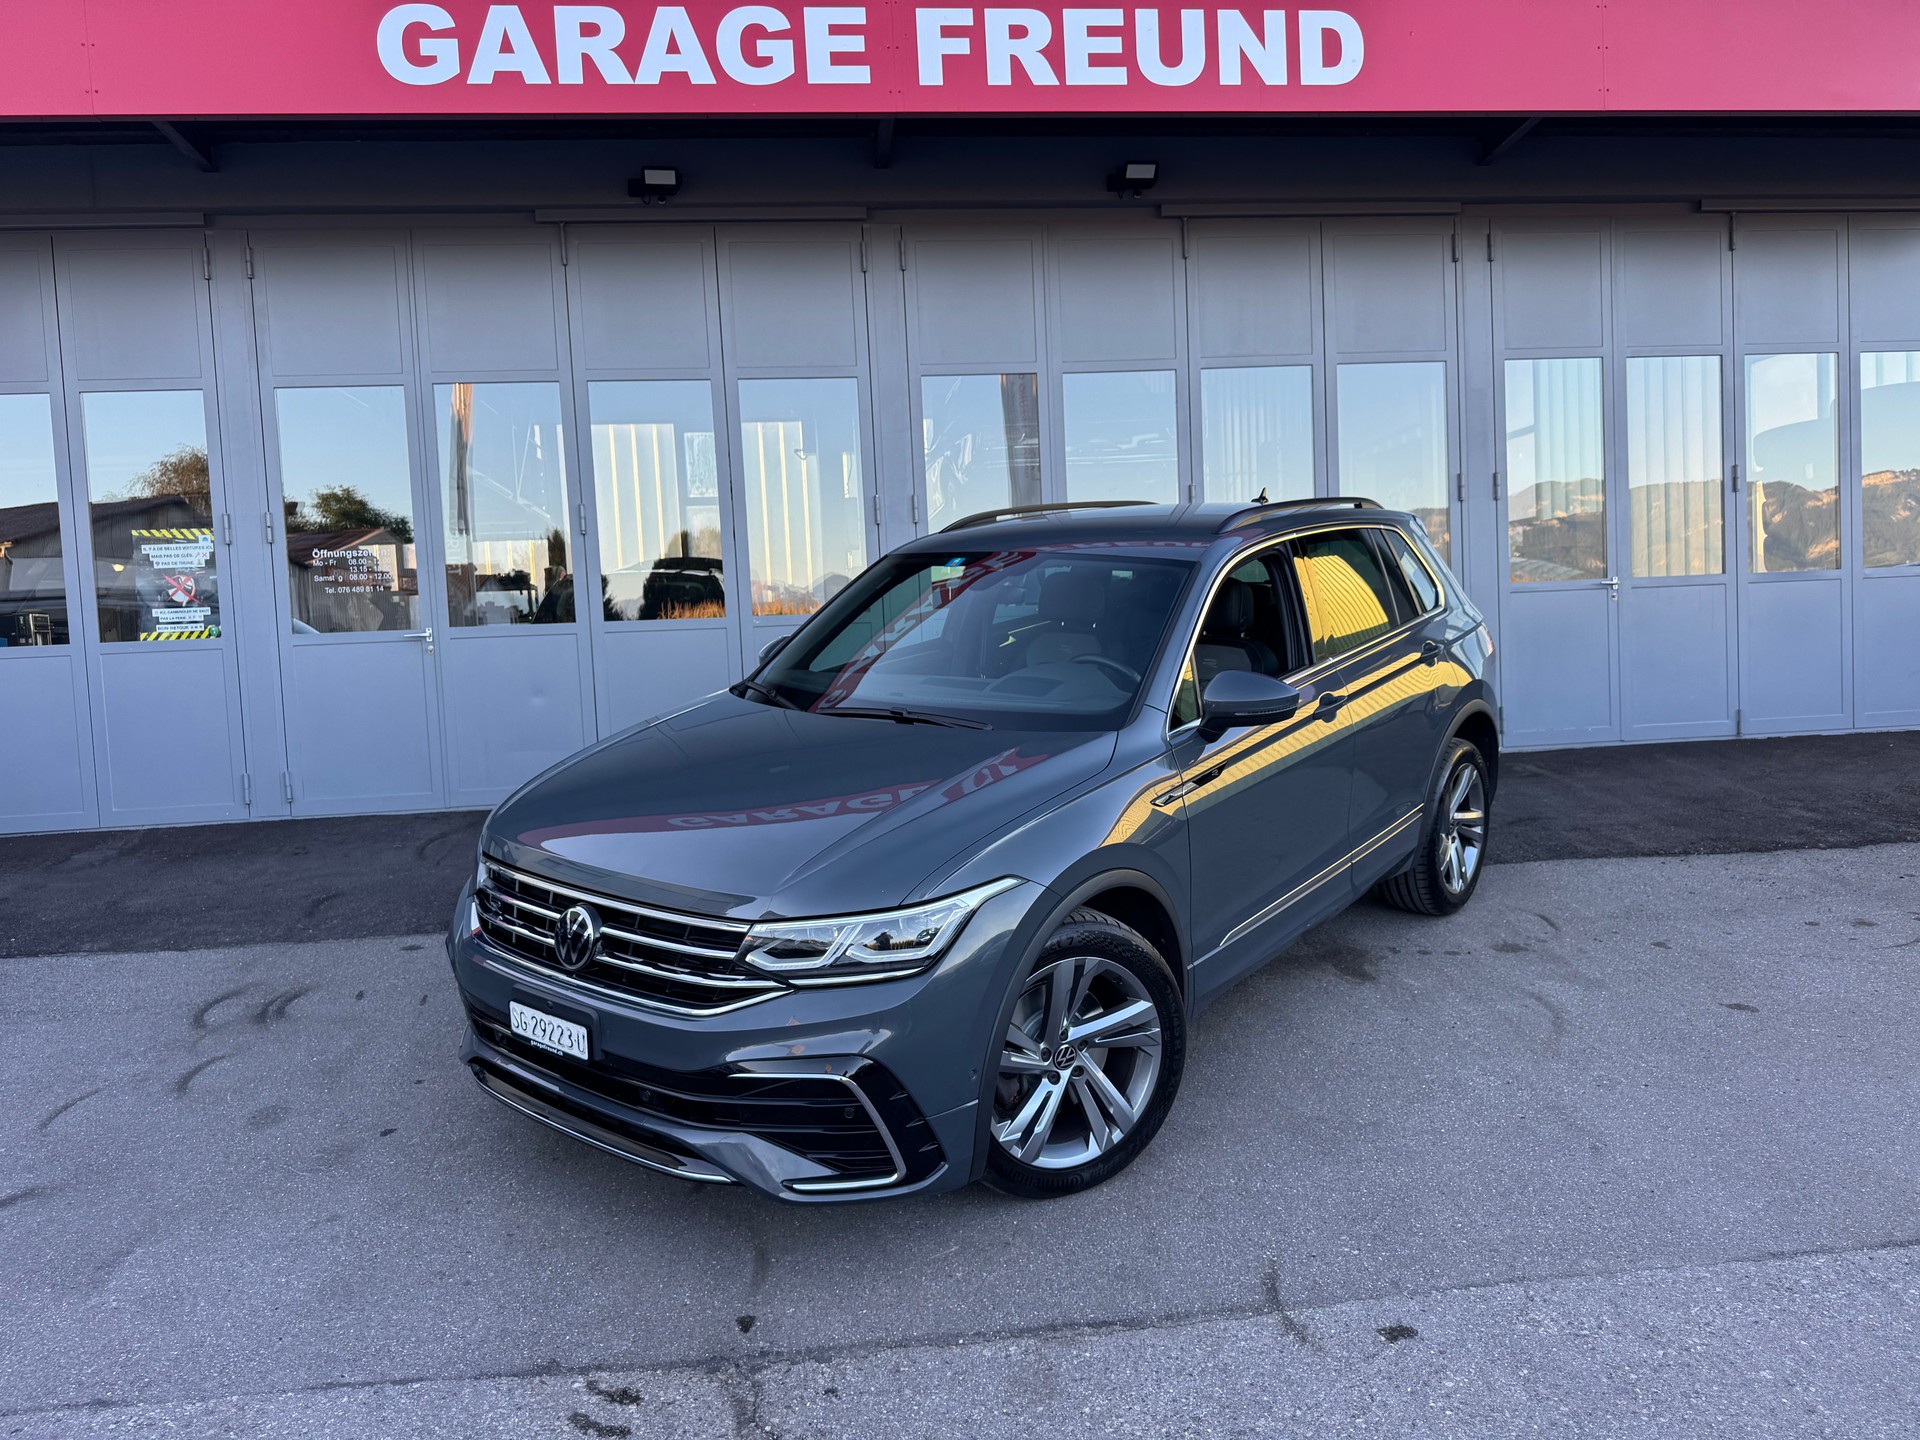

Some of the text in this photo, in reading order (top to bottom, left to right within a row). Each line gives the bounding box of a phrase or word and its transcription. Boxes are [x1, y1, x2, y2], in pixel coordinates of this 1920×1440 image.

[376, 3, 1365, 87] GARAGE FREUND
[312, 548, 390, 559] Öffnungszein:
